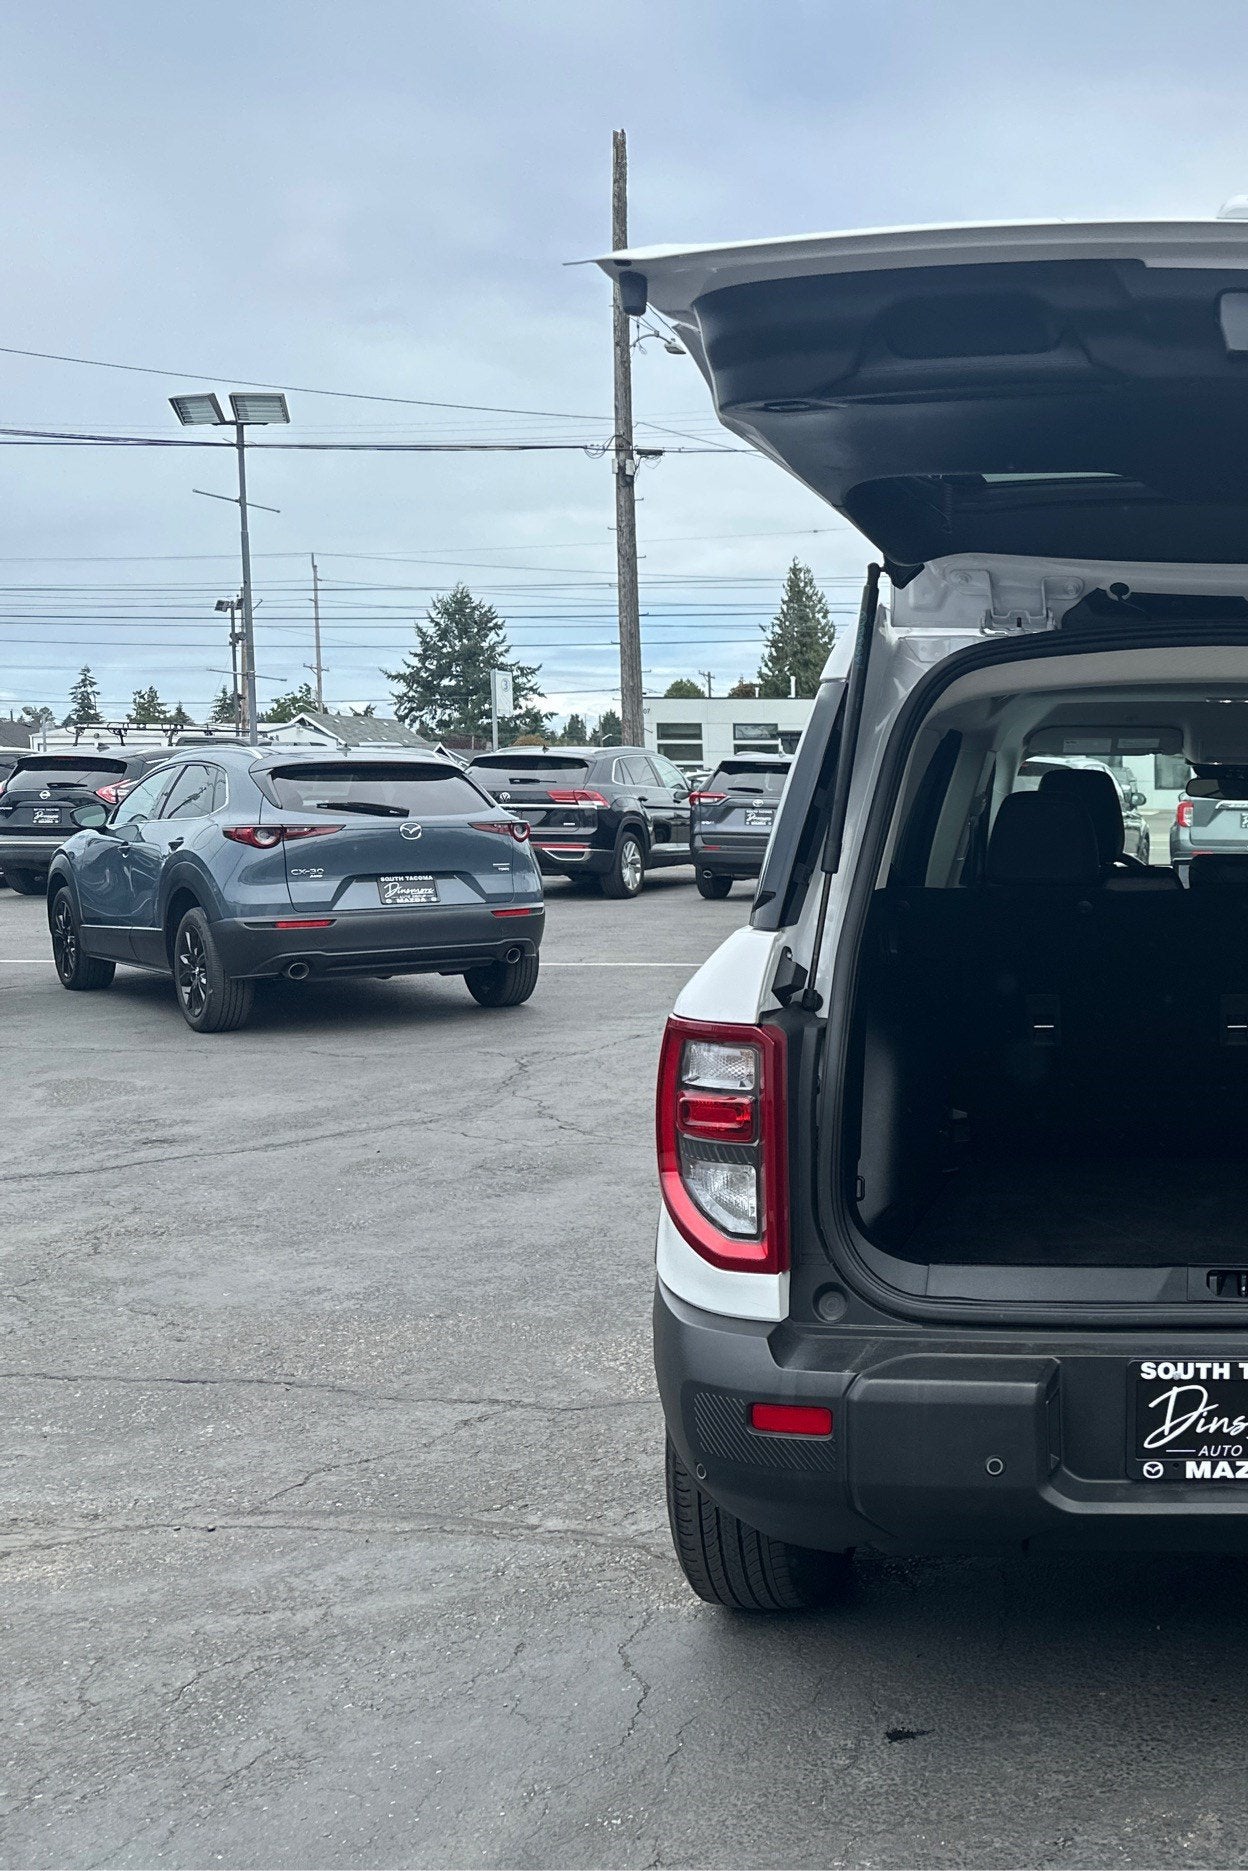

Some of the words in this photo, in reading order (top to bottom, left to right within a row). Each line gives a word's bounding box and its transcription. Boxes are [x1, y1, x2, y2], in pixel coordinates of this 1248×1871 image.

[290, 868, 324, 876] CX-30
[1140, 1362, 1231, 1380] SOUTH
[1197, 1445, 1244, 1457] AUTO
